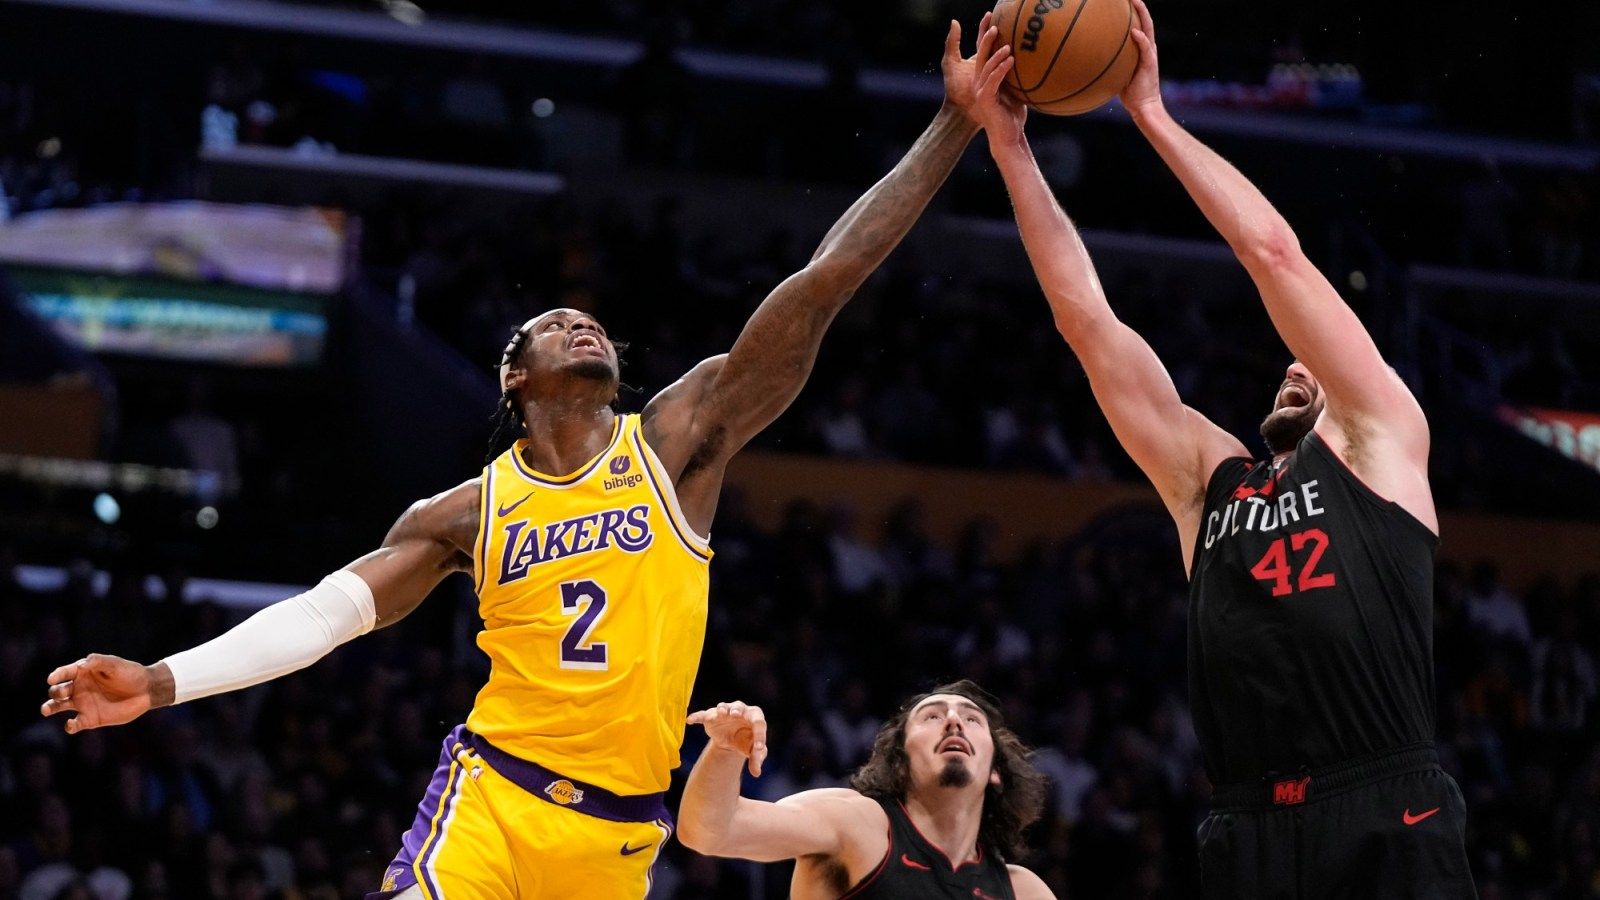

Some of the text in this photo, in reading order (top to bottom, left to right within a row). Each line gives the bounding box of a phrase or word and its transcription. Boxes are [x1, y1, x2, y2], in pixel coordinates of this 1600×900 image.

[604, 474, 643, 490] bibigo
[498, 504, 654, 586] LAKERS
[1250, 528, 1336, 597] 42
[559, 578, 608, 671] 2
